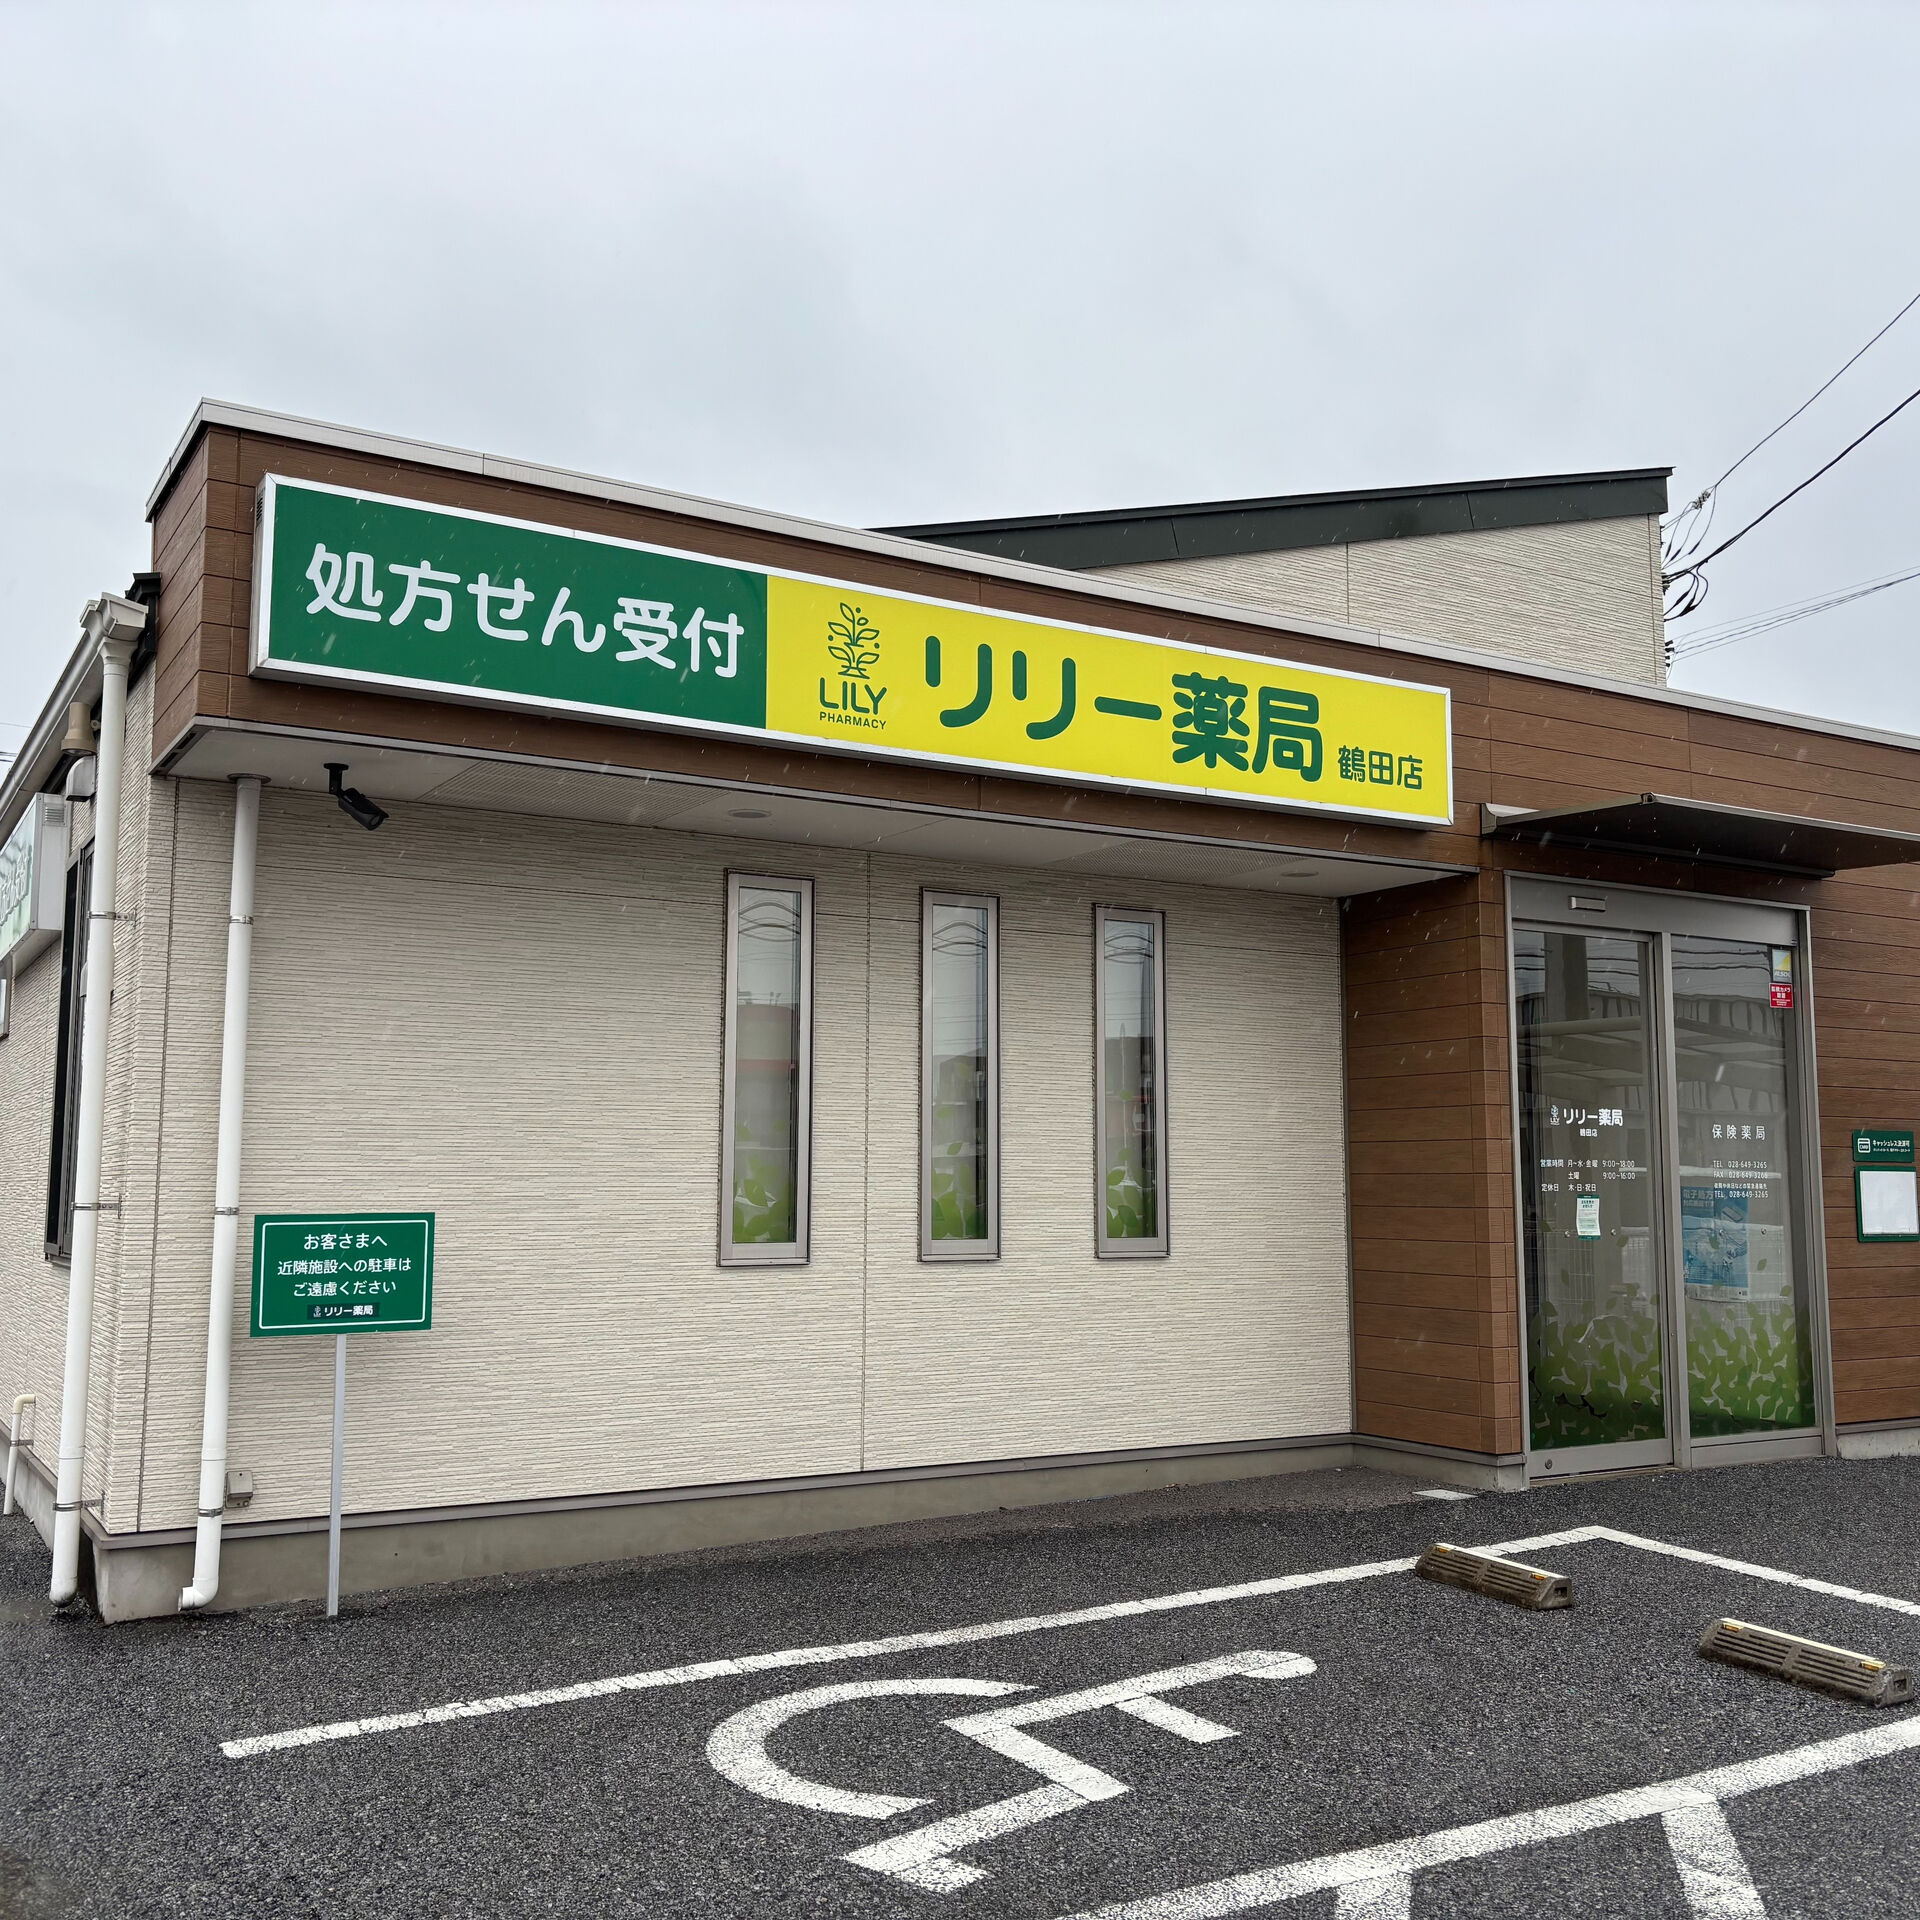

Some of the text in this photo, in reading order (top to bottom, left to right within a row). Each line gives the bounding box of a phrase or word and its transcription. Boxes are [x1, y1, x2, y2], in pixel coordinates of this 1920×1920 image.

[305, 543, 745, 678] 処方せん受付
[819, 676, 888, 715] LILY
[925, 635, 1324, 783] リリー薬局
[819, 711, 887, 731] PHARMACY
[1338, 744, 1424, 791] 鶴田店
[1563, 1108, 1624, 1127] リリー薬局
[1712, 1124, 1766, 1141] 保険薬局
[1713, 1160, 1723, 1168] TEL
[1568, 1172, 1580, 1180] 土曜
[1713, 1170, 1724, 1178] FAX
[1541, 1183, 1559, 1192] 定休日
[1714, 1190, 1724, 1198] TEL
[303, 1232, 388, 1251] お客さまへ
[277, 1257, 412, 1276] 近隣施設への駐車は
[293, 1280, 397, 1298] ご遠慮ください
[324, 1304, 374, 1317] リリー薬局
